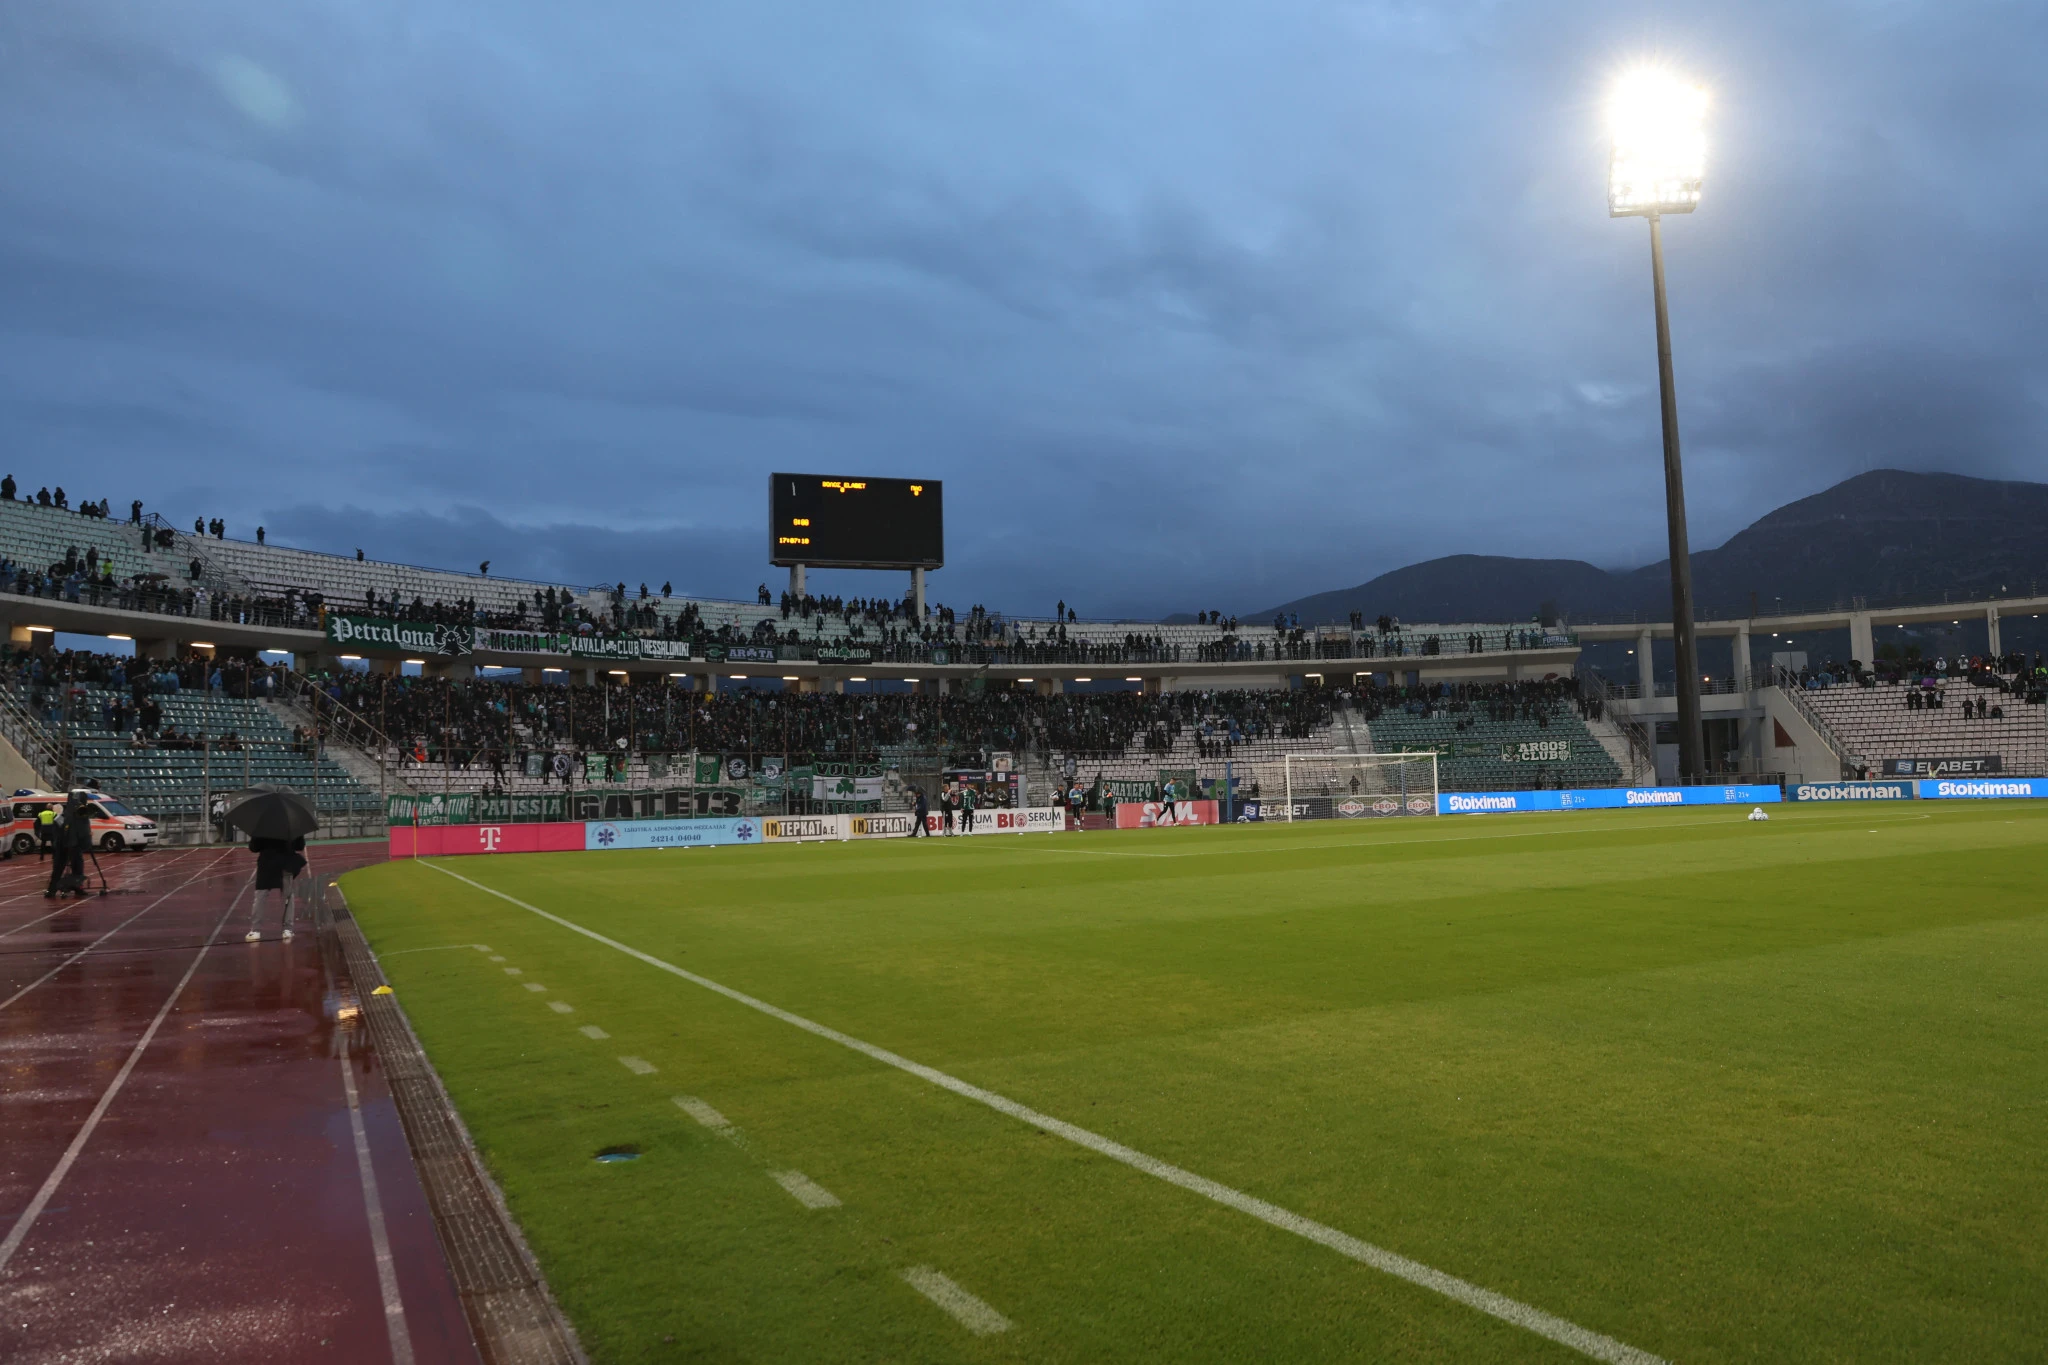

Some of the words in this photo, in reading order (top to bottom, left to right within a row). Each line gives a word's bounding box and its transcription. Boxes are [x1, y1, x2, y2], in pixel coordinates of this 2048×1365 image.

[331, 616, 436, 646] Petralona
[490, 631, 540, 652] MEGARA
[544, 633, 558, 653] 13
[571, 636, 606, 654] KAVALA
[617, 640, 640, 655] CLUB
[640, 638, 690, 657] THESSALONIKI
[1518, 740, 1568, 752] ARGOS
[1521, 750, 1559, 761] CLUB
[815, 763, 883, 776] VOLOS
[1916, 760, 1985, 773] ELABET
[1627, 790, 1682, 804] Stoiximan
[1797, 785, 1902, 801] Stoiximan
[1938, 782, 2032, 797] Stoiximan
[475, 799, 561, 816] PATISSIA
[566, 788, 691, 820] GATE
[692, 790, 743, 816] 13
[813, 802, 854, 815] GATE
[1449, 795, 1516, 811] Stoiximan
[1028, 811, 1062, 822] SERUM
[480, 827, 501, 851] T
[650, 835, 674, 843] 24214
